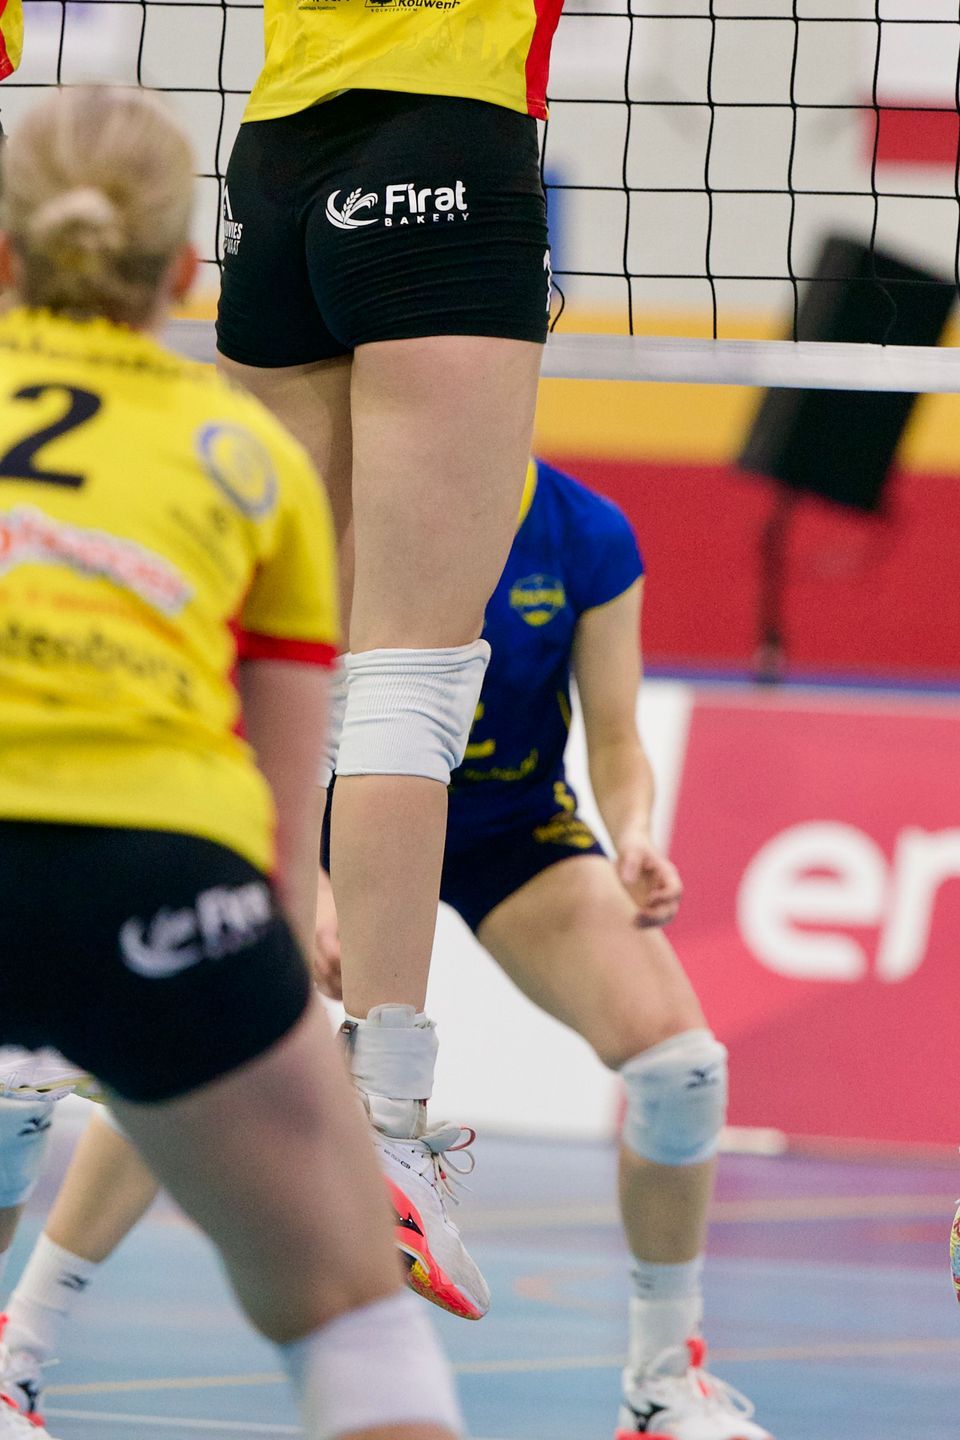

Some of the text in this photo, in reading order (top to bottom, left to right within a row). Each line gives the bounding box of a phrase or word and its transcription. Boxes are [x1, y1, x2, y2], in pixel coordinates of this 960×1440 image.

[385, 180, 468, 214] Firat
[385, 212, 470, 227] BAKERY
[0, 383, 104, 489] 2
